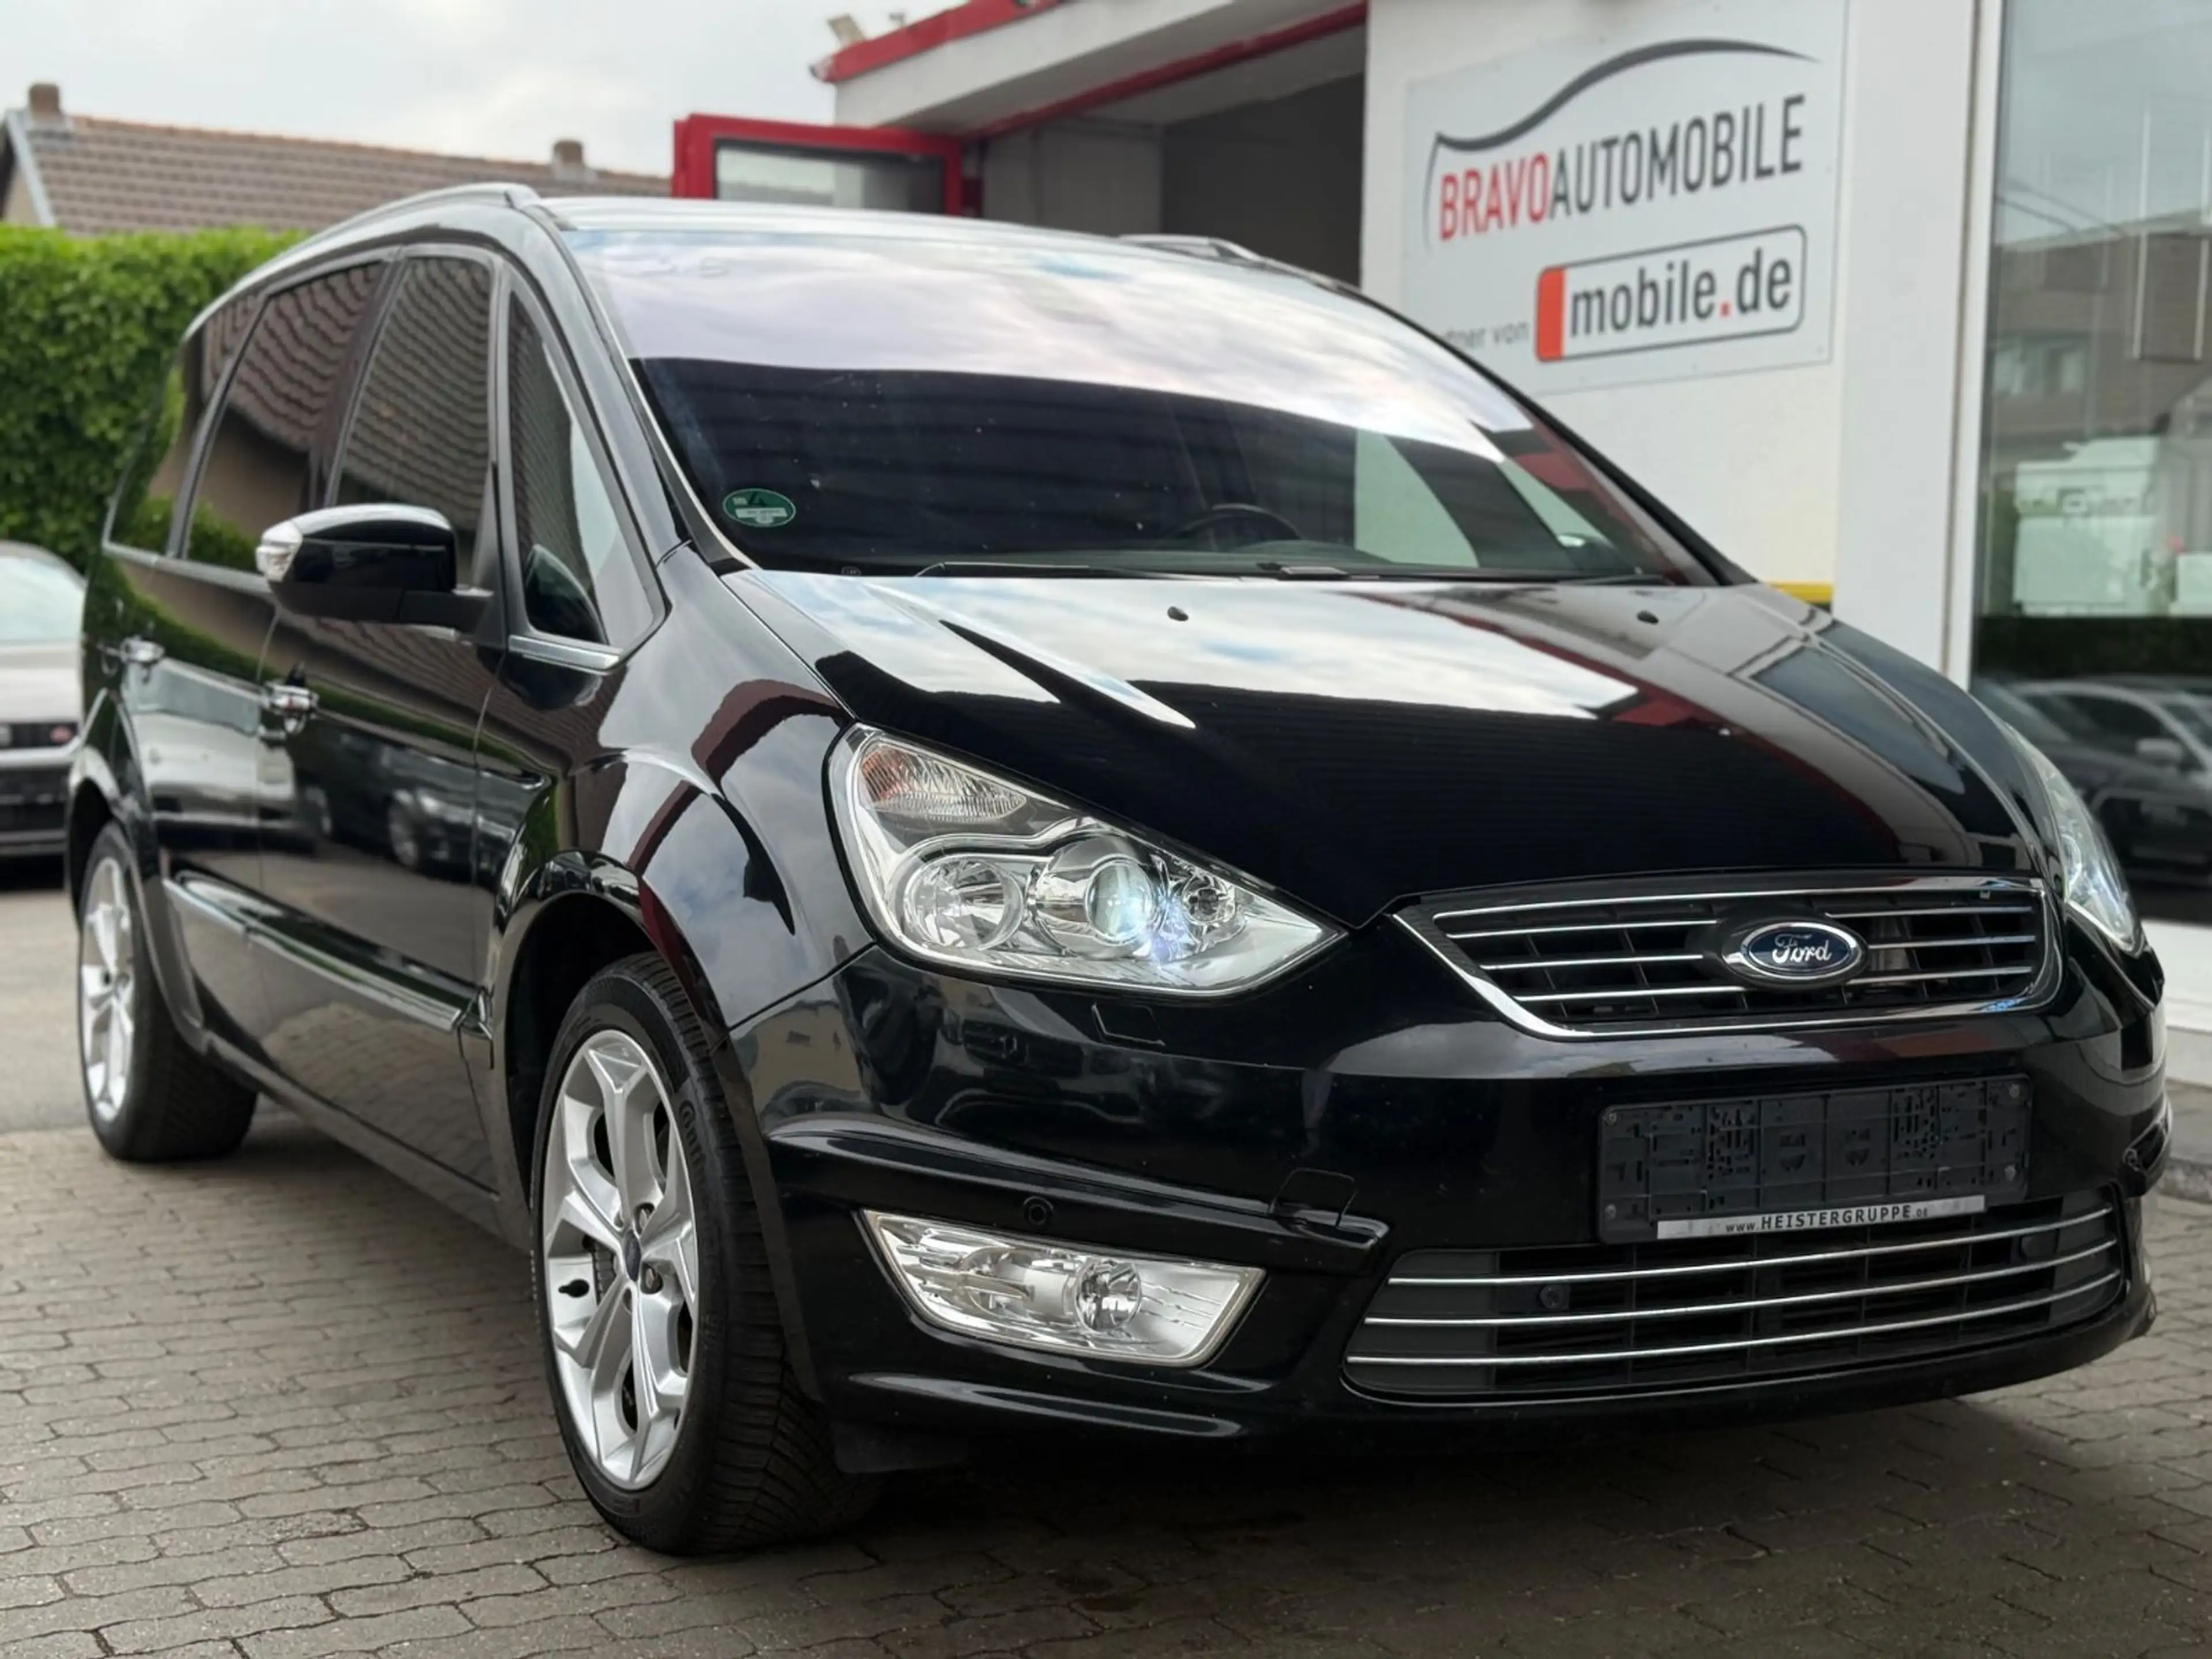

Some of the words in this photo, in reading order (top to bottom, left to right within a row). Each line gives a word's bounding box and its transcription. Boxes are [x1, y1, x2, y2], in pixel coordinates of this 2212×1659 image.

[1439, 93, 1805, 242] BRAVOAUTOMOBILE
[1493, 321, 1530, 344] von
[1570, 247, 1793, 339] mobile.de
[1772, 933, 1834, 964] Ford
